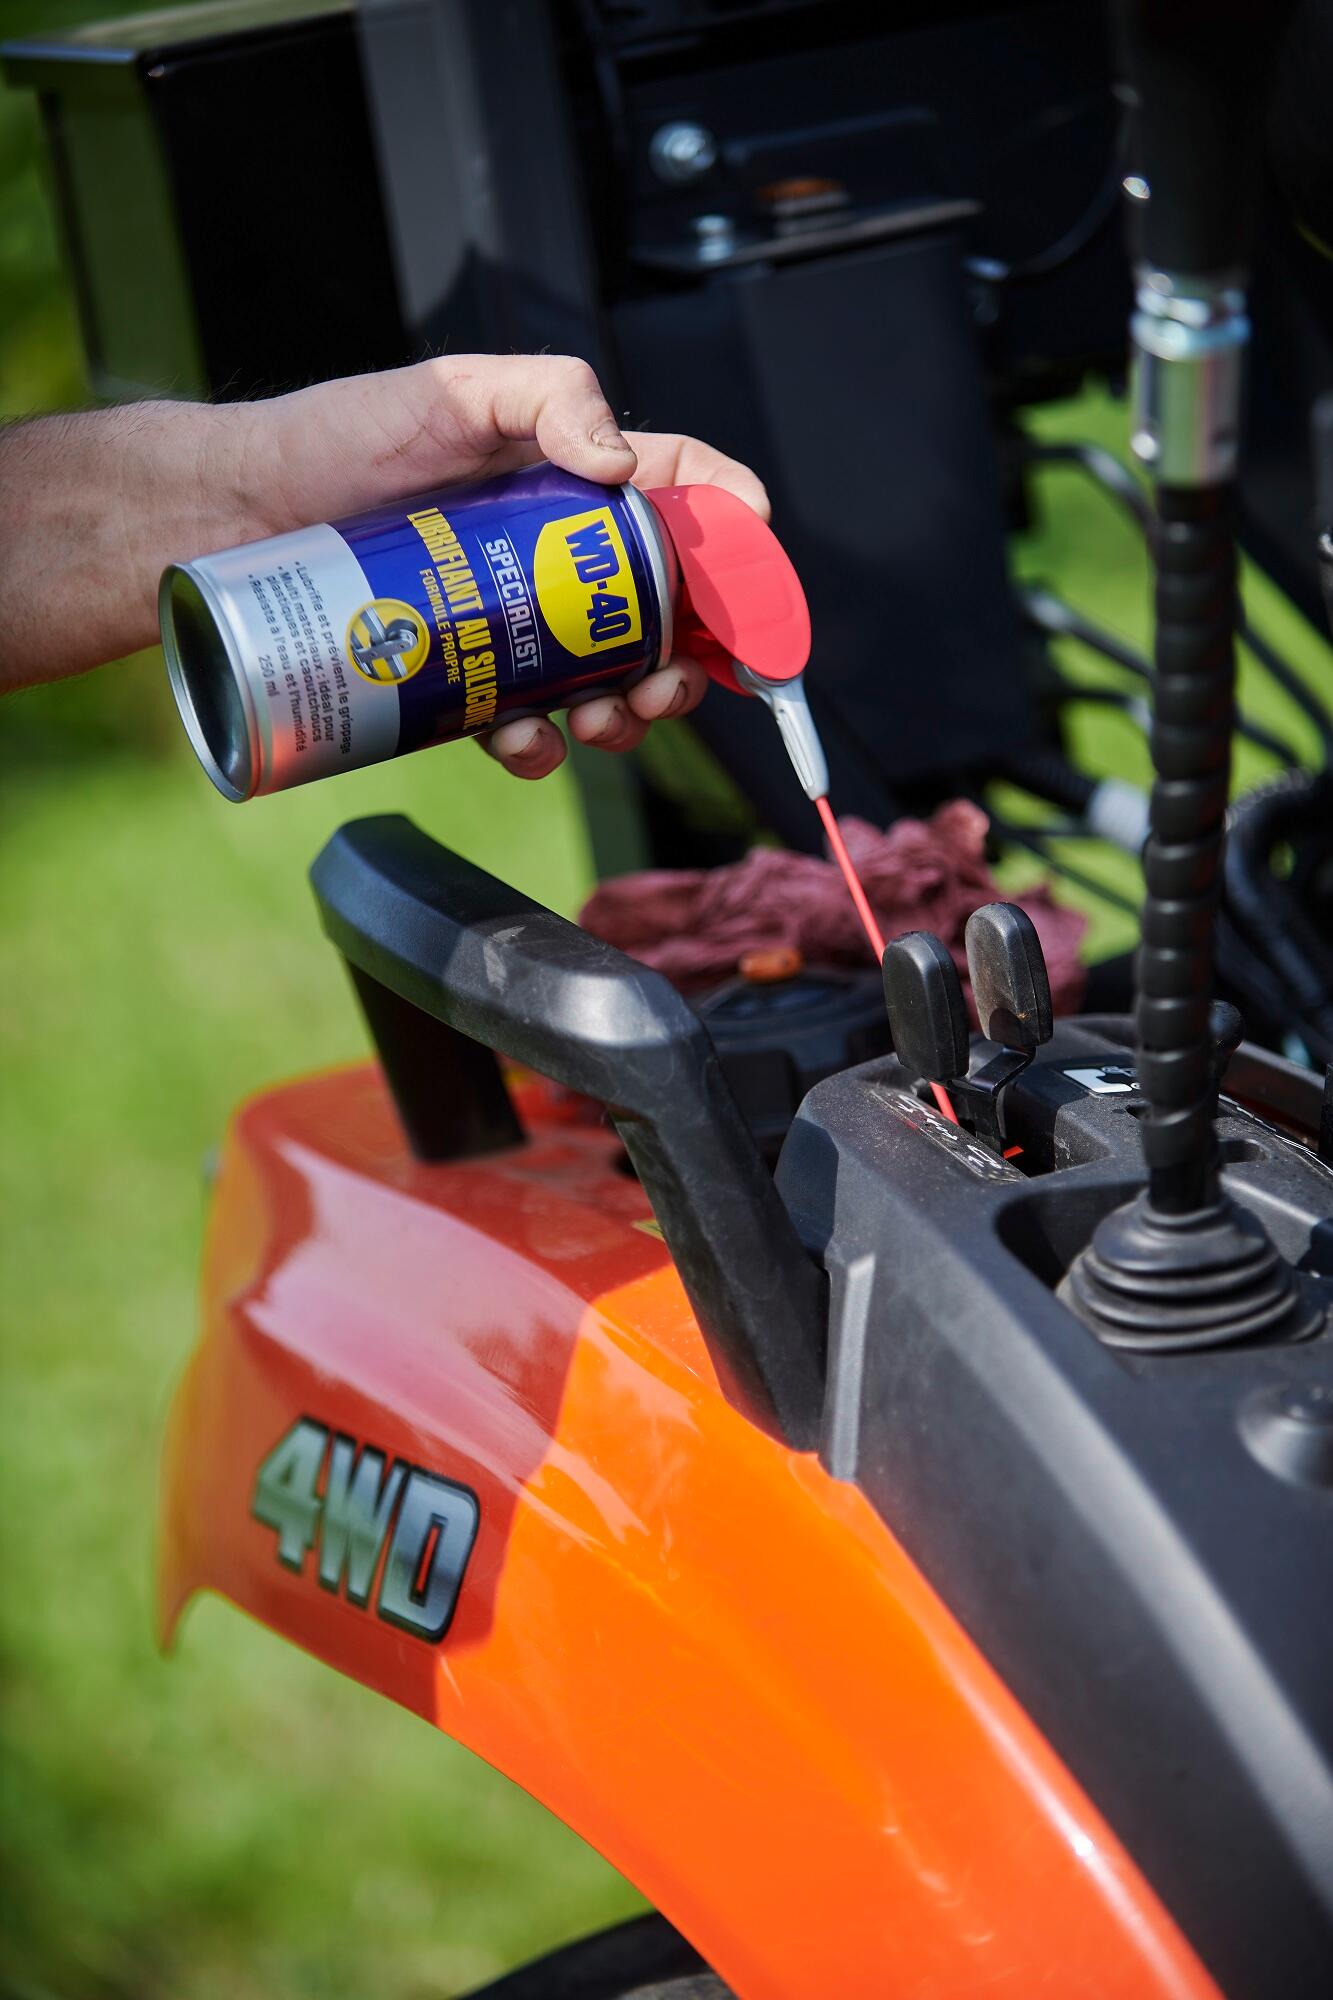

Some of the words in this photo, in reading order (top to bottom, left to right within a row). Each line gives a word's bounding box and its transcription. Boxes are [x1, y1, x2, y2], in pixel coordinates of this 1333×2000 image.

[407, 507, 484, 614] LUBRIFIANT
[565, 519, 631, 642] WD-40
[250, 579, 276, 624] Résiste
[266, 576, 300, 637] plastiques
[280, 571, 300, 600] Multi
[296, 566, 324, 611] Lubrifie
[294, 602, 324, 671] matériaux
[318, 614, 330, 628] et
[419, 568, 450, 631] FORMULE
[440, 632, 461, 684] PROPRE
[455, 617, 492, 651] AU
[258, 655, 275, 678] 250
[273, 636, 291, 670] l'eau
[294, 640, 306, 655] et
[321, 631, 345, 689] prévient
[265, 681, 280, 697] ml
[285, 673, 298, 689] et
[299, 658, 323, 742] caoutchoucs
[318, 680, 334, 712] idéal
[338, 691, 349, 705] le
[462, 650, 498, 730] SILICONE
[288, 690, 308, 752] l'humidité
[322, 714, 335, 742] pour
[339, 708, 352, 754] grippage
[251, 1414, 481, 1645] 4WD
